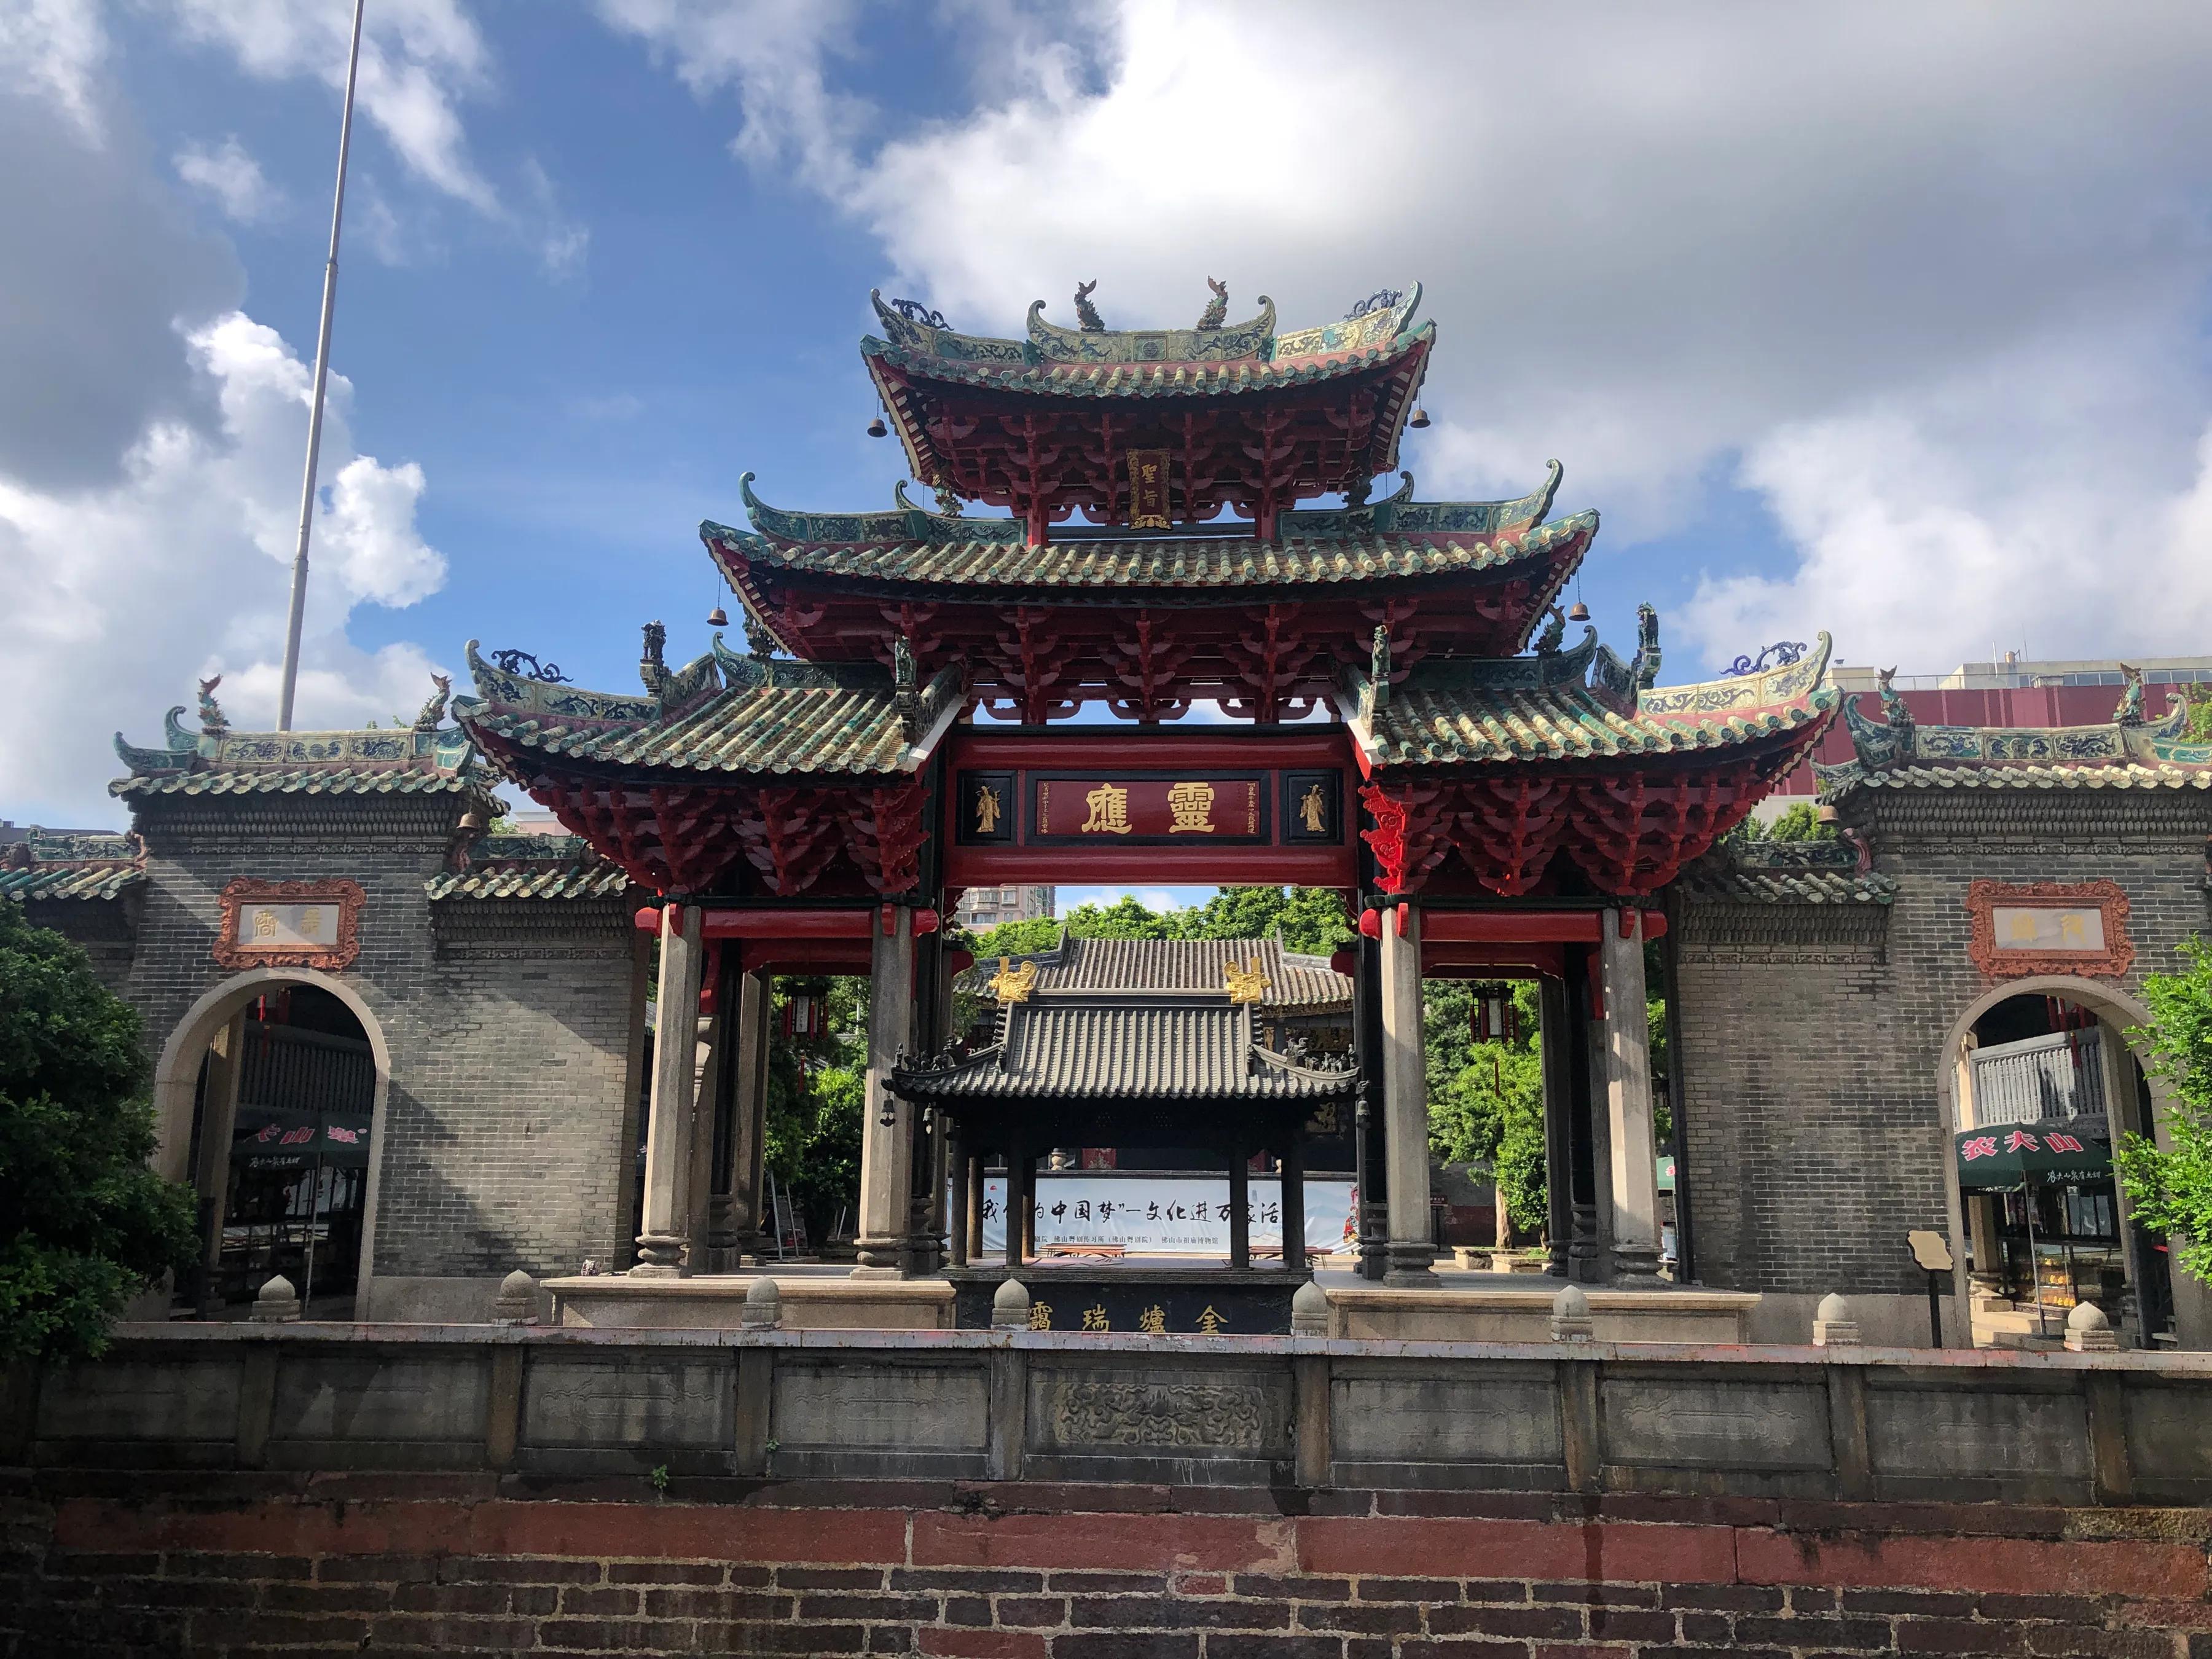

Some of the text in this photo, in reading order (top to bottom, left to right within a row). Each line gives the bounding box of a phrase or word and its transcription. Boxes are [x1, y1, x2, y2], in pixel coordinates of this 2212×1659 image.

[1141, 463, 1158, 508] 聖旨
[1081, 782, 1215, 834] 靈應
[1961, 1130, 2085, 1162] 农夫山
